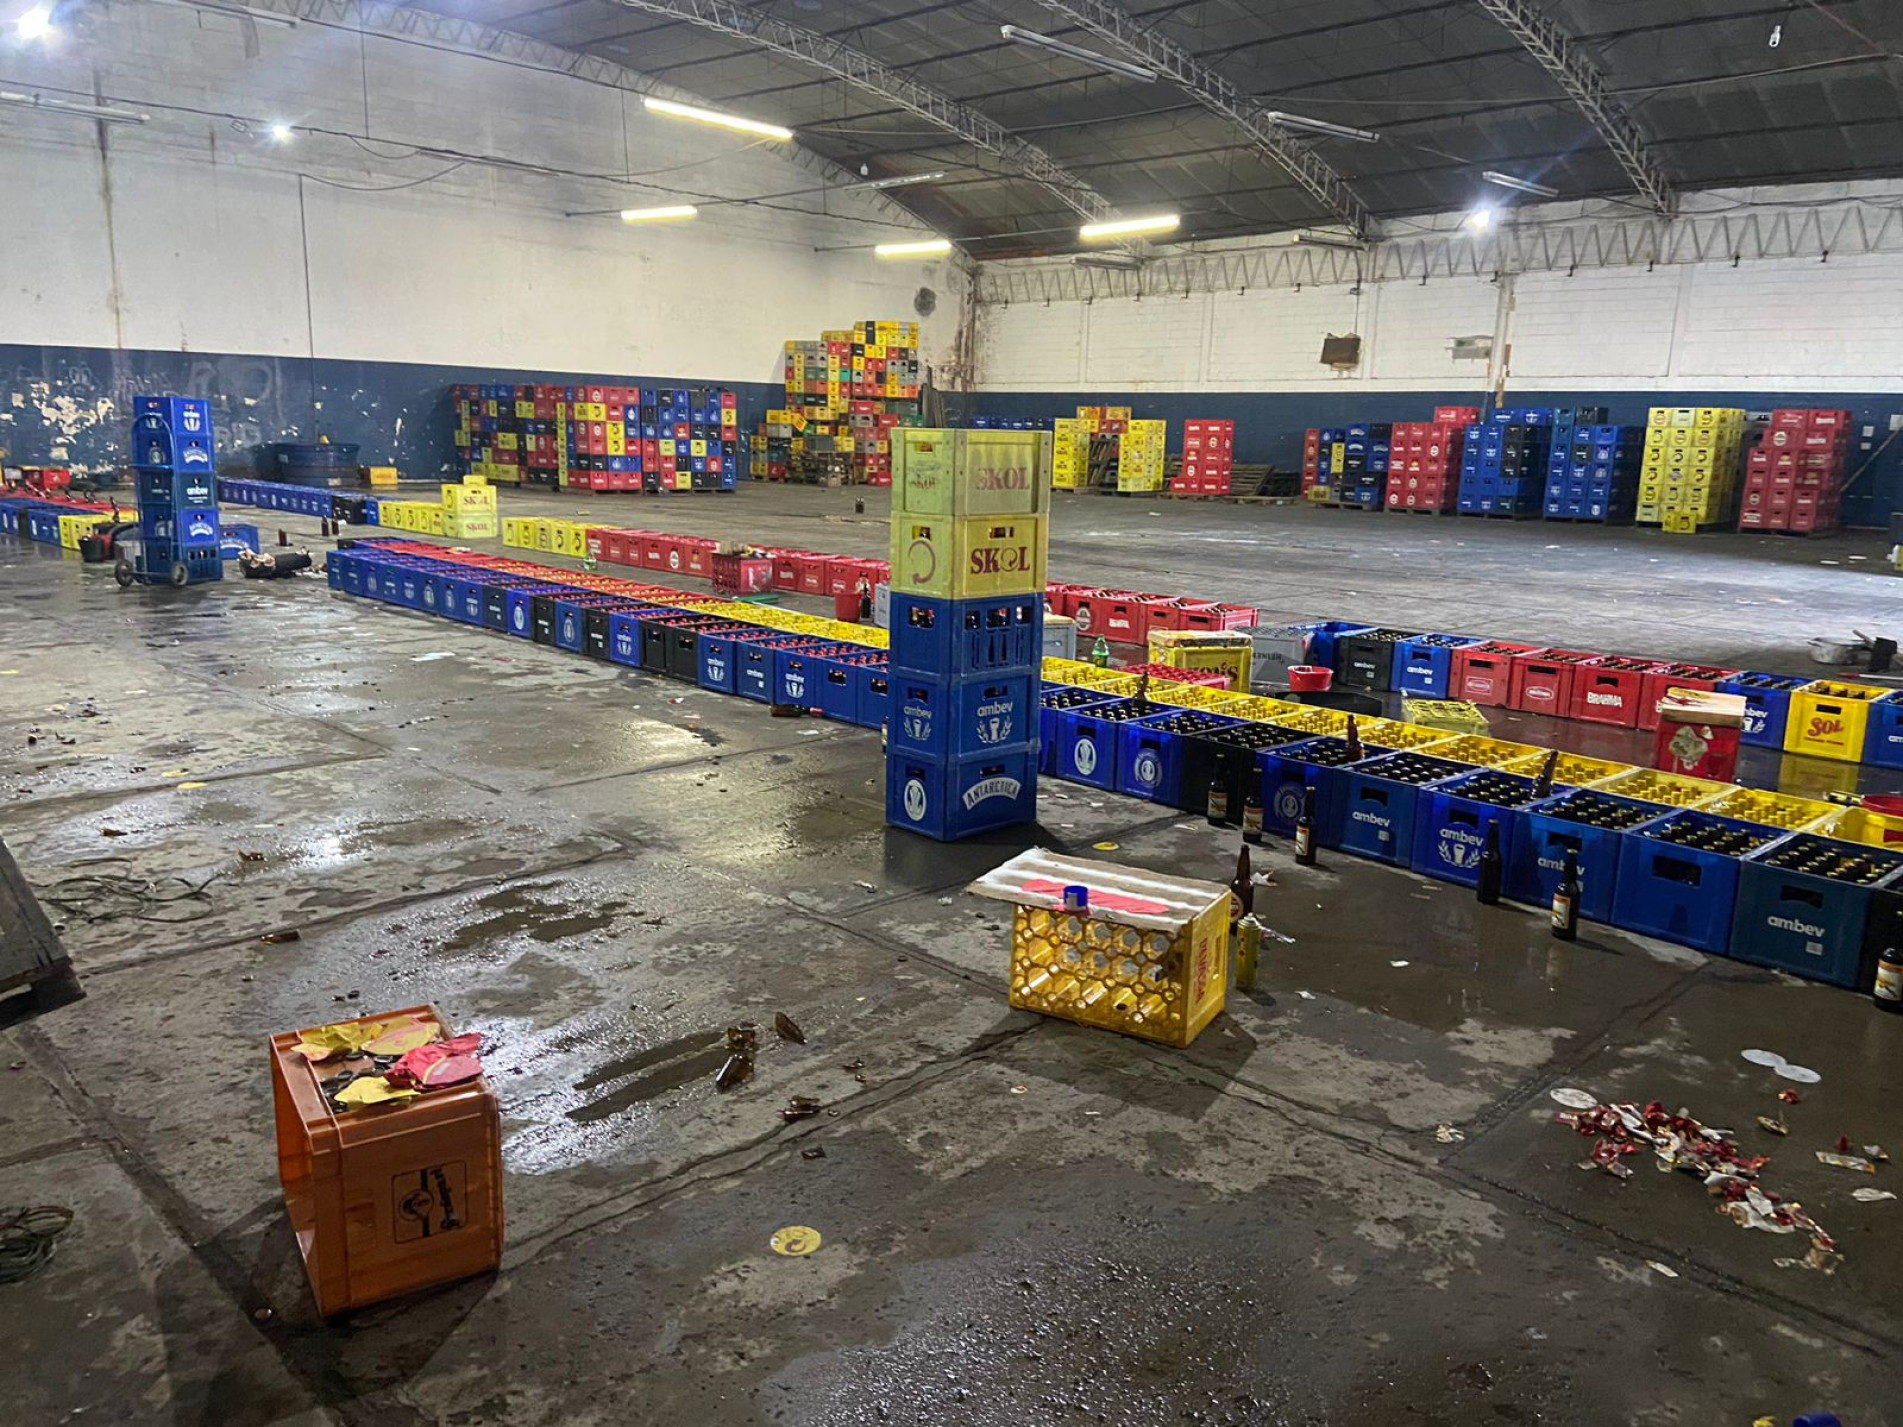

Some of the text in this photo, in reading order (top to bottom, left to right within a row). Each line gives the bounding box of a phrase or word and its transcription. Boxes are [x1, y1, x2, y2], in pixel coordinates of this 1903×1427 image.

[975, 467, 1029, 490] SKOL
[970, 547, 1030, 574] SKOL
[903, 705, 932, 719] ambev
[977, 701, 1013, 717] ambev
[1352, 811, 1390, 827] ambev
[1440, 829, 1483, 846] ambev
[1767, 915, 1825, 938] ambev
